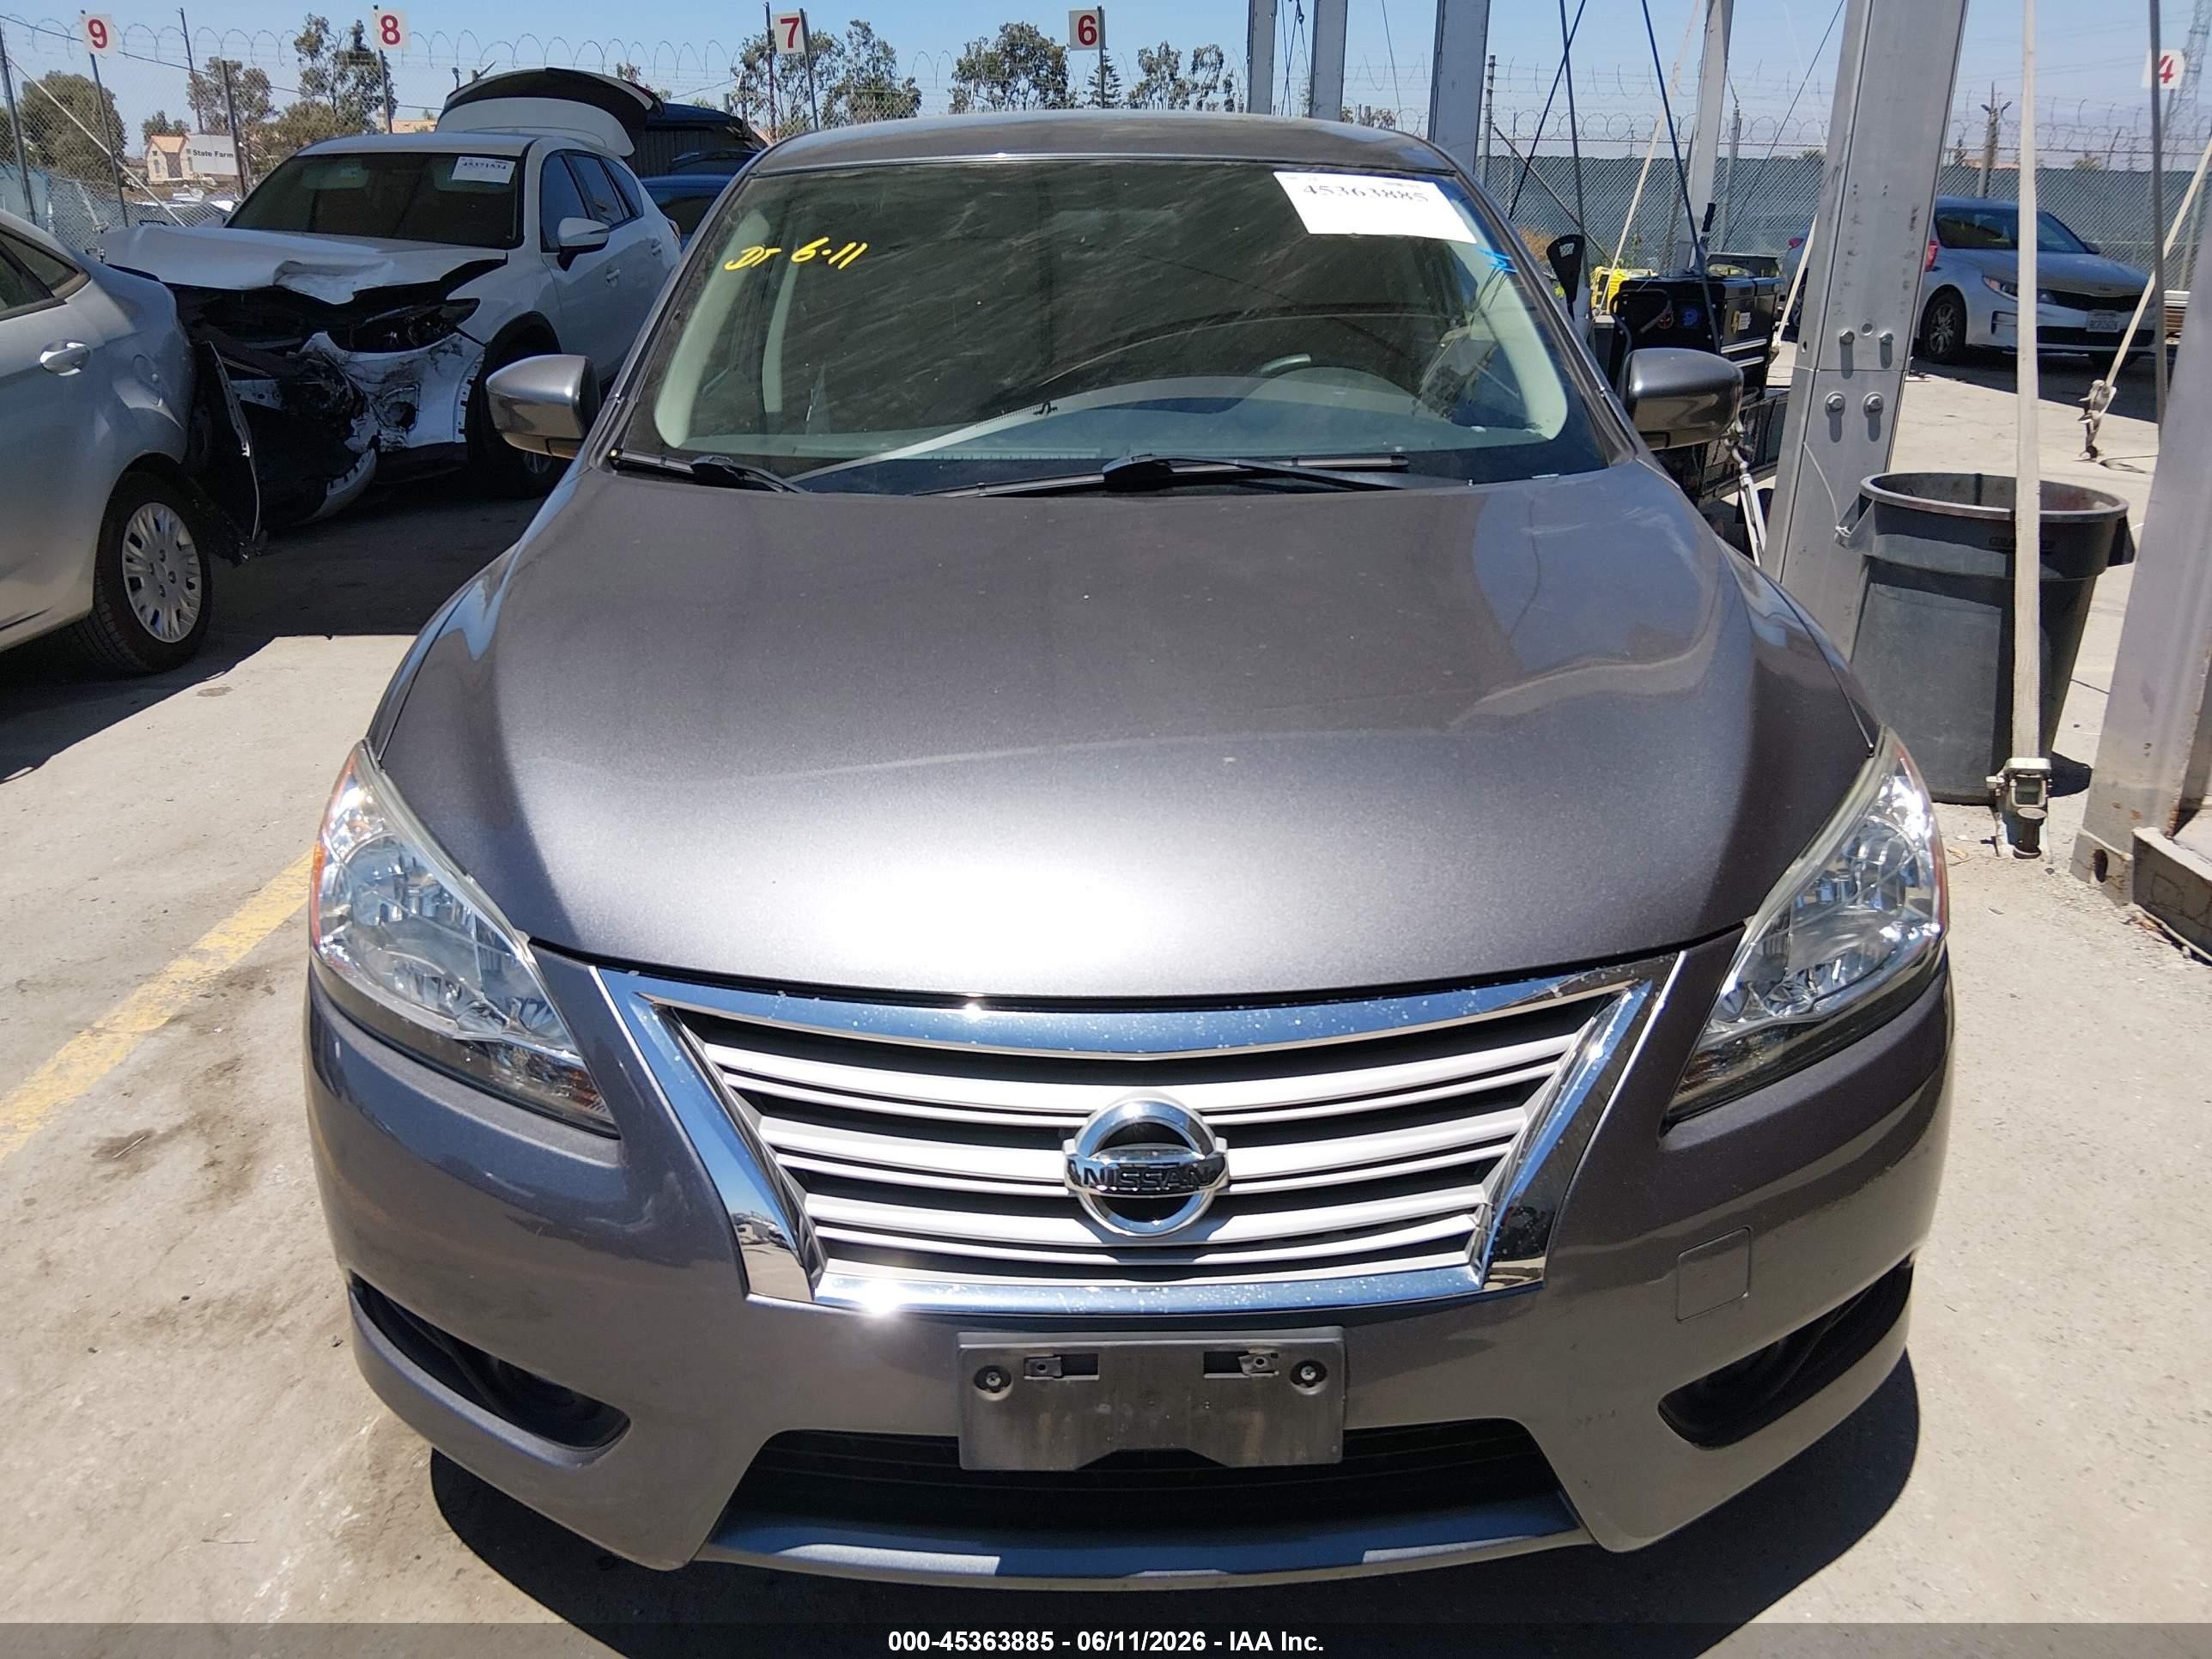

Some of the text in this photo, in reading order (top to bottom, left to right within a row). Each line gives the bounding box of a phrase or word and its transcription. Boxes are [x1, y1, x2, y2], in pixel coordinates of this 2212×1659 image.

[88, 19, 107, 49] 9
[380, 15, 401, 46] 8
[781, 17, 799, 48] 7
[1078, 15, 1097, 46] 6
[2159, 55, 2174, 84] 4
[1303, 185, 1429, 202] 45363885
[1083, 1161, 1210, 1191] NISSAN
